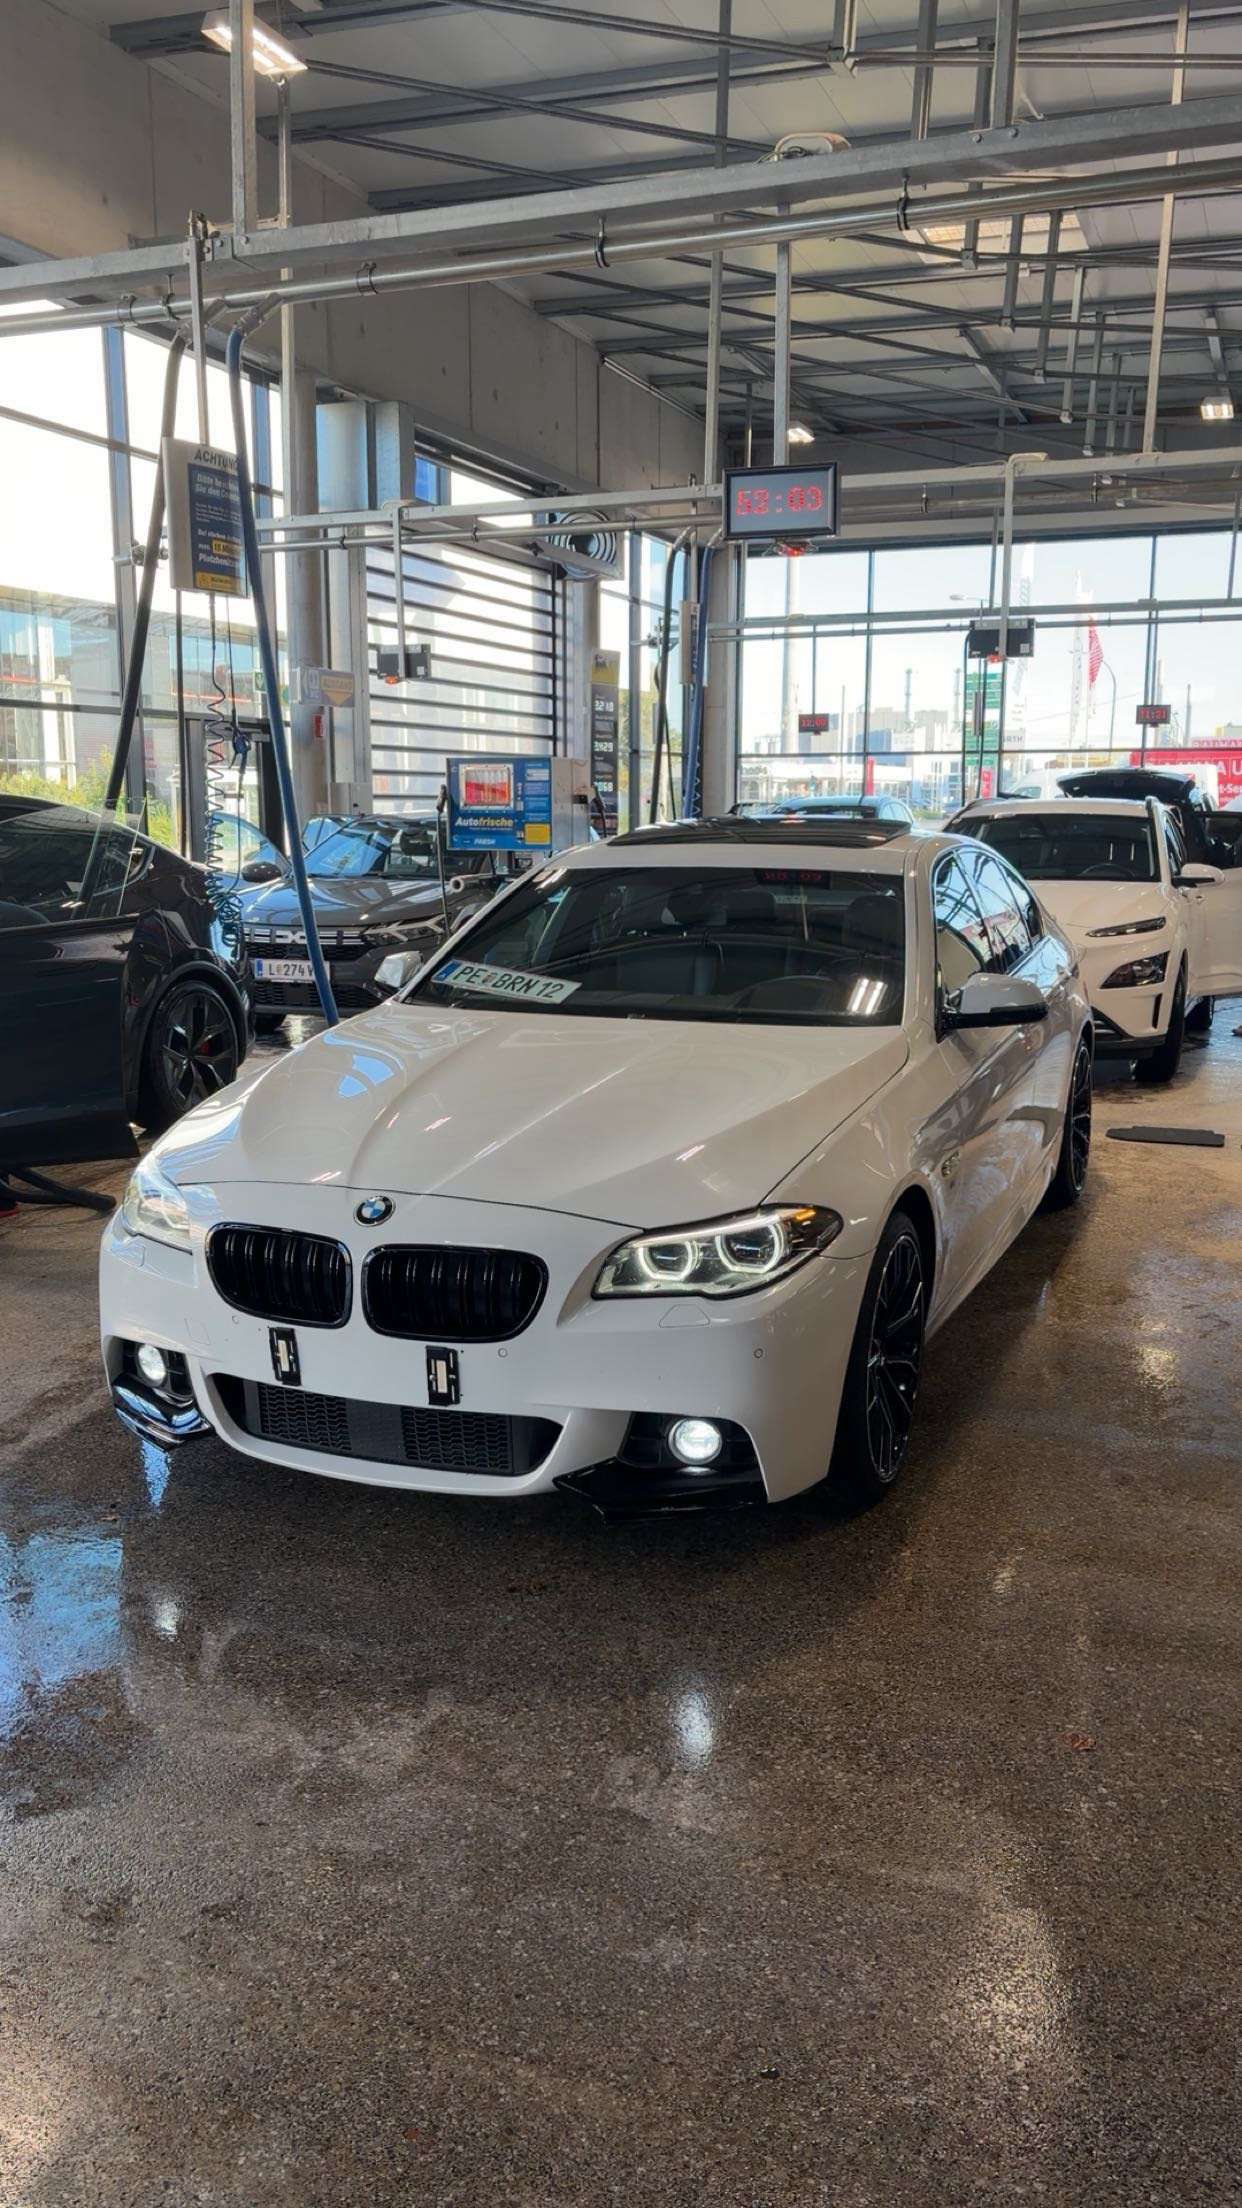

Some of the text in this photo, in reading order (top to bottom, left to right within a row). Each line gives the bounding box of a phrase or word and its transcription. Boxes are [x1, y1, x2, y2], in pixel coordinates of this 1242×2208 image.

[454, 817, 514, 827] Autofrische
[268, 962, 276, 976] L
[453, 965, 566, 999] PE BRN 12
